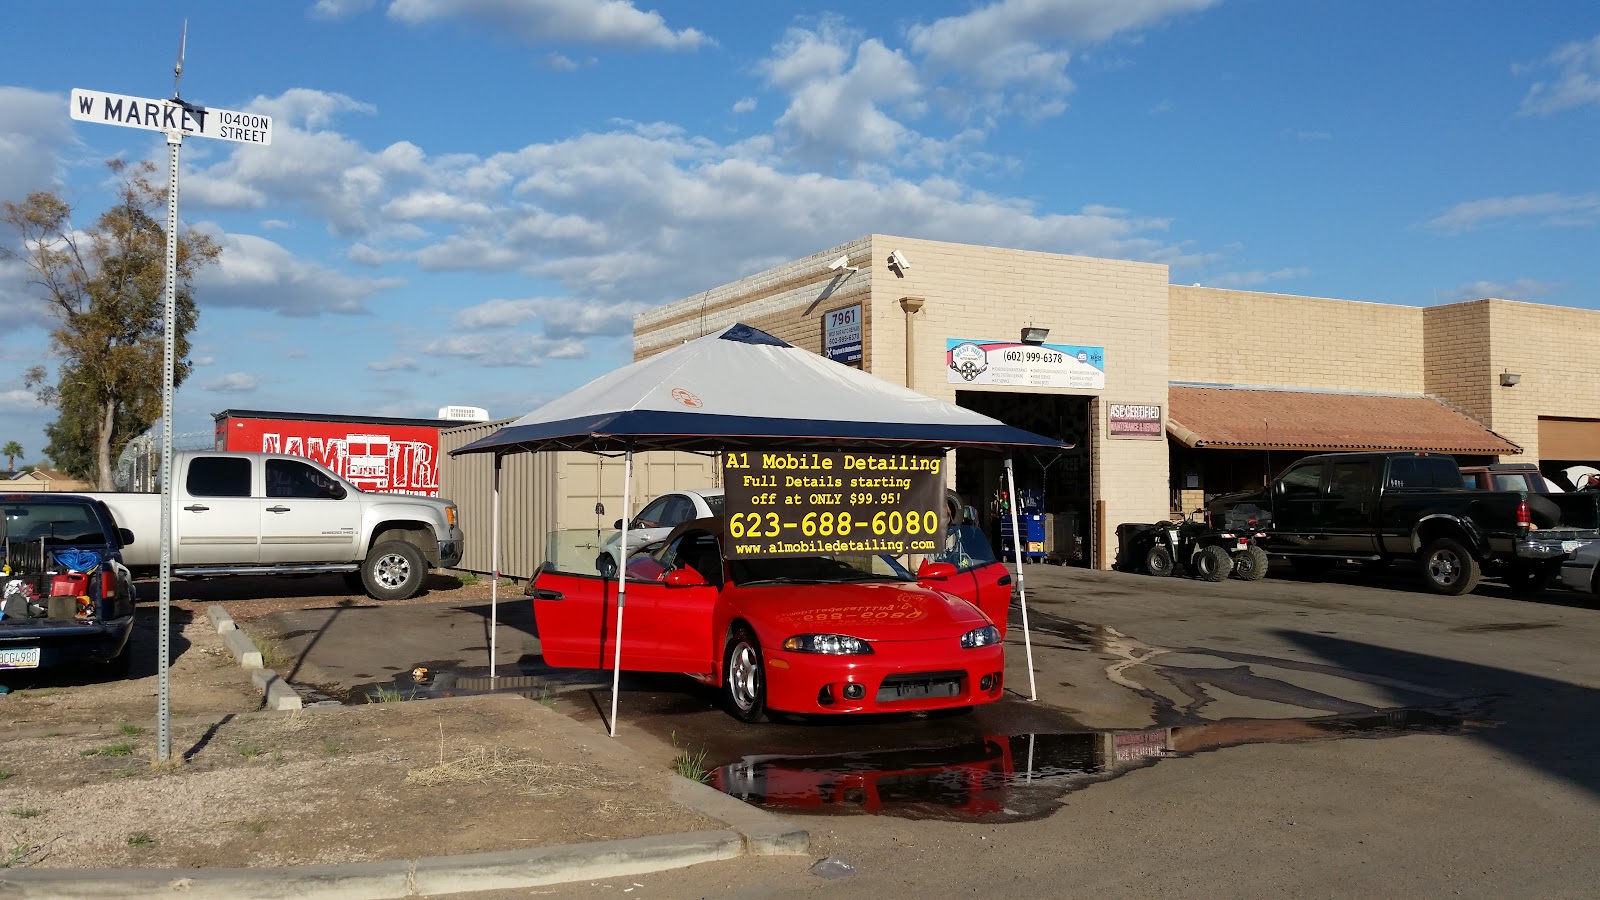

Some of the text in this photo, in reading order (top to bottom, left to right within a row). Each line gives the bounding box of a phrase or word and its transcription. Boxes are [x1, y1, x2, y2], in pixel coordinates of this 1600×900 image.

[79, 95, 209, 133] W MARKET
[219, 112, 268, 130] 10400N
[220, 126, 266, 143] STREET
[832, 310, 854, 327] 7961
[955, 346, 984, 360] WEST SIDE
[1003, 350, 1063, 364] (602) 999-6378
[1110, 404, 1160, 418] ASE CERTIFIED
[762, 454, 833, 470] Mobile
[844, 455, 941, 474] Detailing
[743, 475, 911, 489] Full Details starting
[751, 492, 901, 506] off at ONLY $99.95!
[729, 511, 938, 538] 623-688-6080
[736, 540, 935, 554] www.a1mobiledetailing.com
